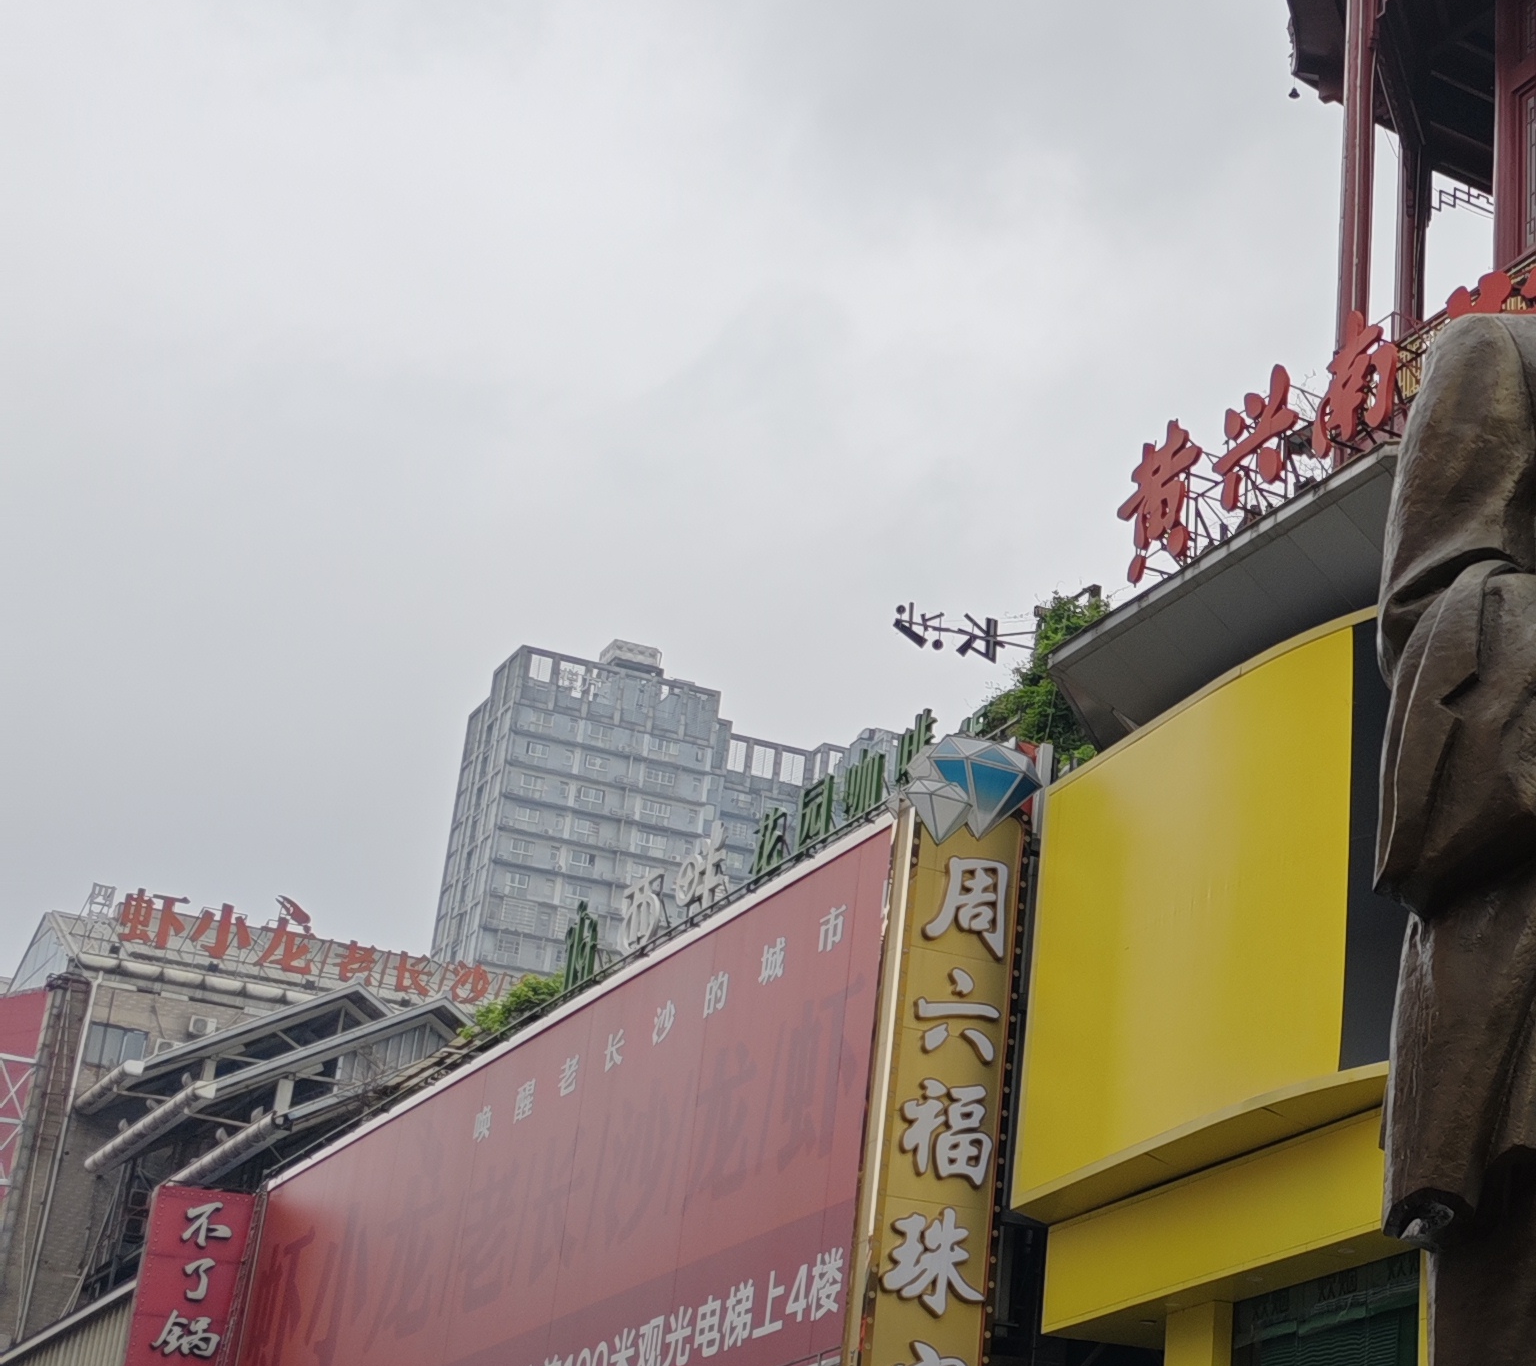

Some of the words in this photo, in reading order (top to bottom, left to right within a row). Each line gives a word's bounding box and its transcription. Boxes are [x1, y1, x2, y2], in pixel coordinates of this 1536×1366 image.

[472, 875, 892, 1143] 唤醒老长沙的城市
[150, 1202, 232, 1359] 不了锅
